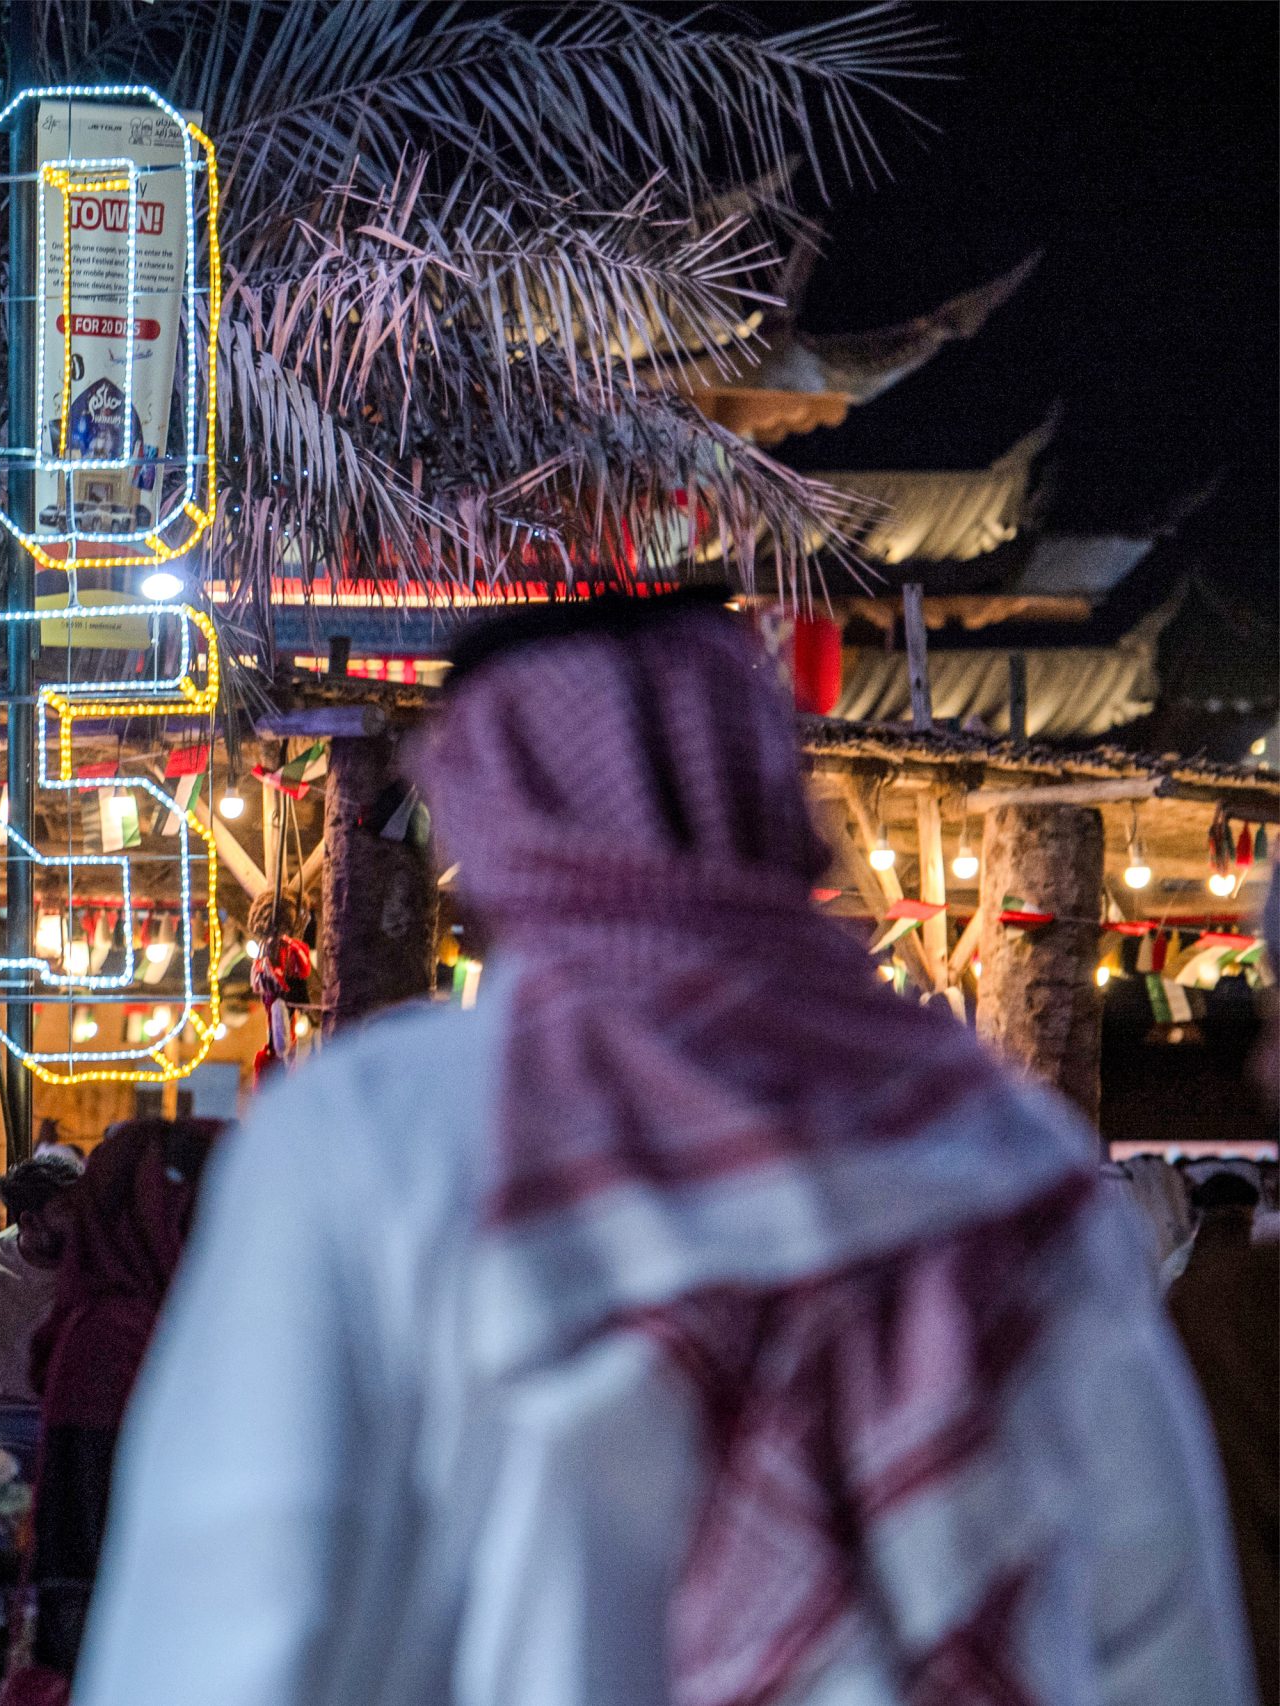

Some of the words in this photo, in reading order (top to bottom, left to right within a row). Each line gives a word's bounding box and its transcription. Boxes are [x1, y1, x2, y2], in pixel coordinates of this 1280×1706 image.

[70, 196, 102, 231] TO
[102, 198, 165, 235] WN!
[75, 317, 99, 334] FOR
[101, 319, 113, 334] 20
